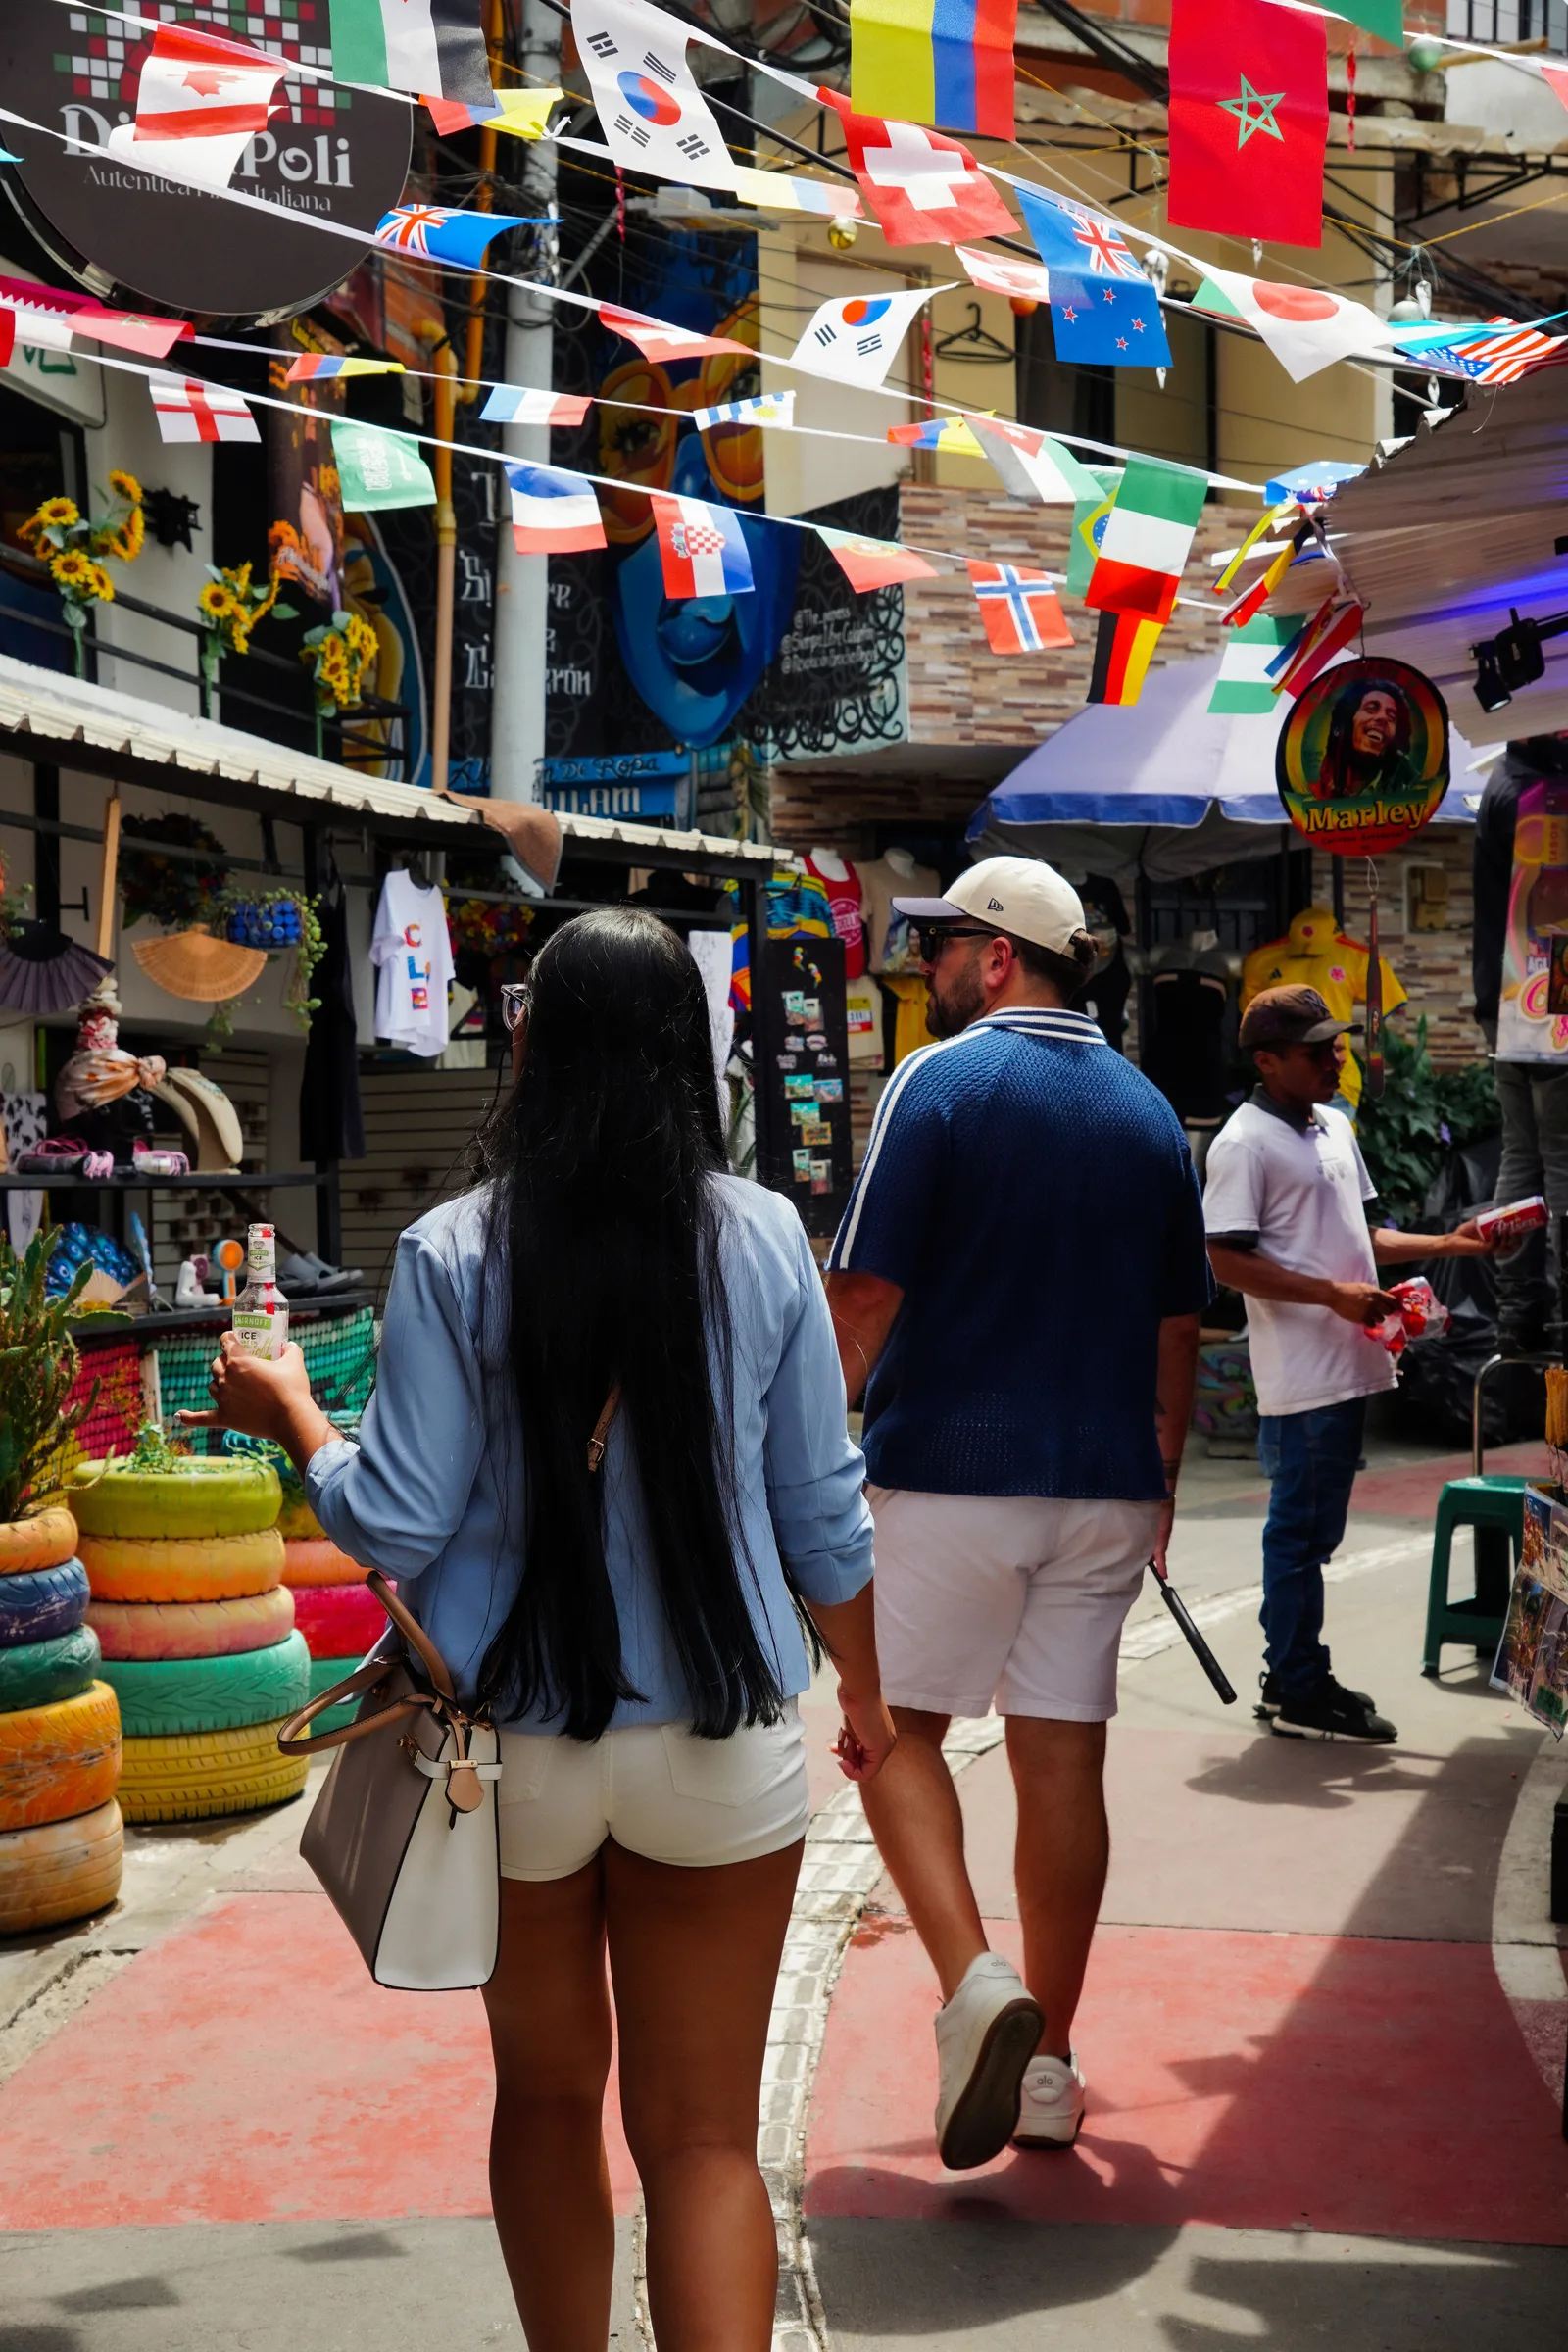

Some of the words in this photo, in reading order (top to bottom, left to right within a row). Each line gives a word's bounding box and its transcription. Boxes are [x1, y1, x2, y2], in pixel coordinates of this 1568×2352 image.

[1307, 799, 1428, 833] Marley
[234, 1316, 269, 1327] SMIRNOFF
[240, 1331, 257, 1341] ICE
[1036, 2074, 1054, 2086] alo
